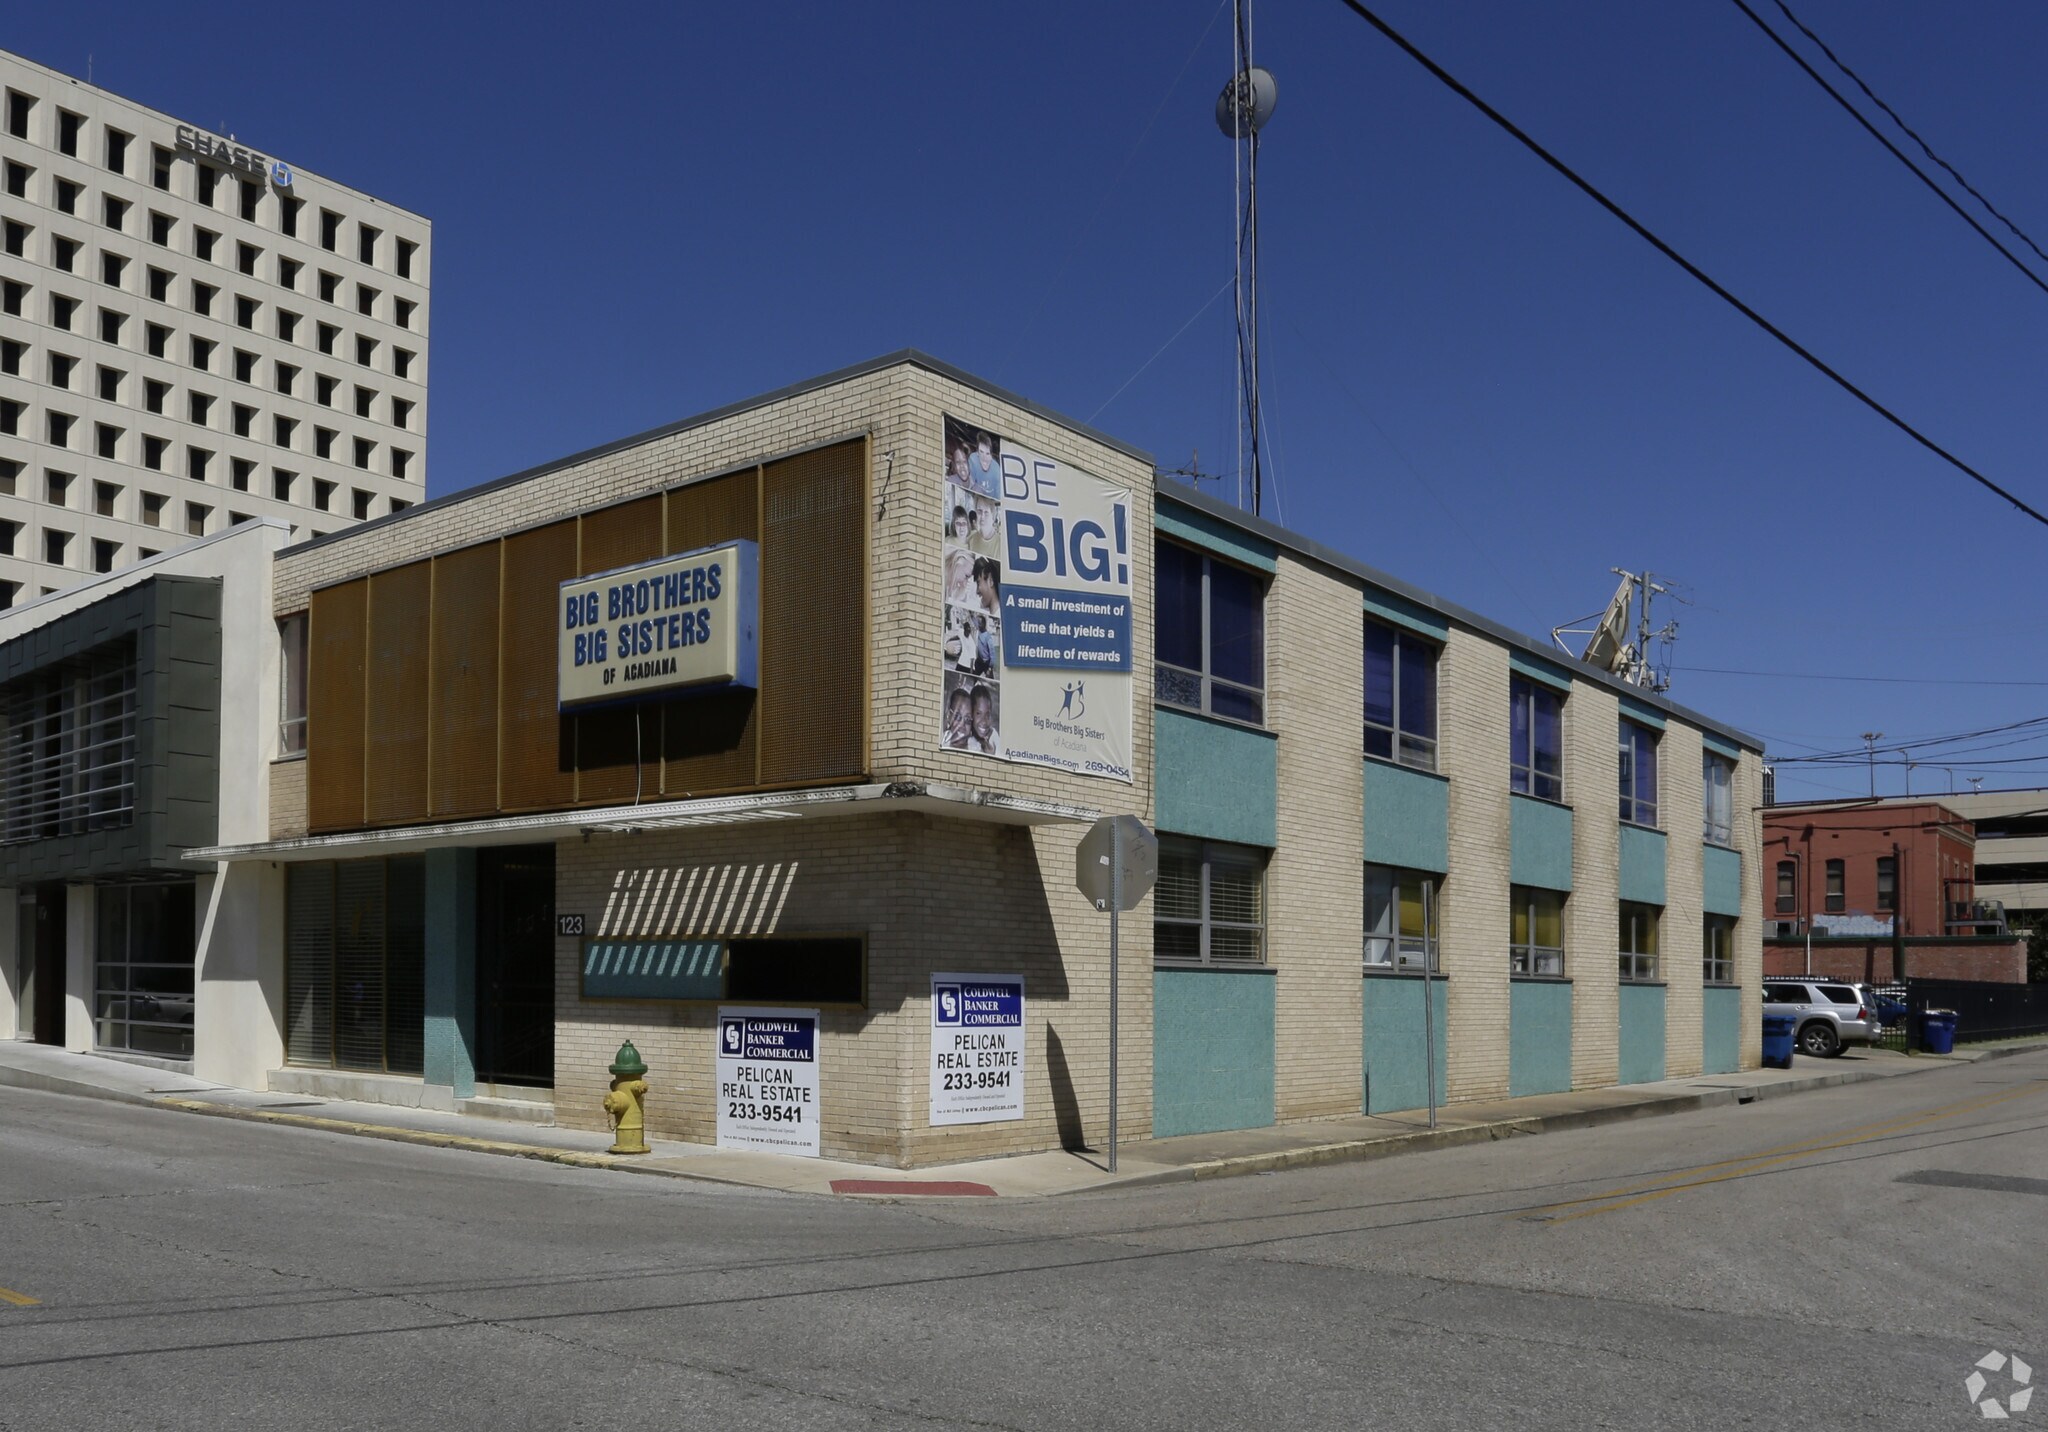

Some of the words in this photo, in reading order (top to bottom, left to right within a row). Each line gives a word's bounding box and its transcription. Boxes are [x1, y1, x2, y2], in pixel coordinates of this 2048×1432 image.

[176, 125, 267, 177] CHASE
[1001, 454, 1059, 507] BE
[1005, 503, 1128, 585] BIG!
[566, 591, 599, 629] BIG
[608, 563, 722, 621] BROTHERS
[1005, 594, 1015, 607] A
[1018, 597, 1049, 610] small
[1051, 598, 1111, 615] investment
[1113, 605, 1124, 616] of
[575, 628, 607, 667] BIG
[617, 607, 711, 658] SISTERS
[1020, 620, 1046, 634] time
[1049, 622, 1071, 636] that
[1073, 625, 1105, 639] yields
[1107, 629, 1115, 639] a
[1018, 645, 1061, 659] lifetime
[1063, 648, 1076, 660] of
[1077, 650, 1121, 663] rewards
[603, 668, 616, 685] OF
[624, 657, 677, 682] ACADIANA
[1033, 715, 1044, 730] Big
[1045, 718, 1073, 736] Brothers
[1073, 725, 1084, 739] Big
[1085, 727, 1105, 741] Sisters
[1005, 747, 1079, 770] AcadianaBigs.com
[1085, 760, 1130, 778] 269-0454
[560, 916, 583, 935] 123
[964, 987, 1011, 998] COLDWELL
[964, 1000, 999, 1011] BANKER
[747, 1020, 800, 1033] COLDWELL
[964, 1013, 1020, 1025] COMMERCIAL
[747, 1033, 784, 1046] BANKER
[954, 1034, 1005, 1050] PELICAN
[746, 1046, 811, 1060] COMMERCIAL
[937, 1053, 971, 1069] REAL
[977, 1051, 1018, 1068] ESTATE
[737, 1066, 793, 1084] PELICAN
[943, 1070, 1010, 1091] 233-9541
[722, 1083, 754, 1099] REAL
[760, 1085, 811, 1103] ESTATE
[728, 1101, 802, 1124] 233-9541
